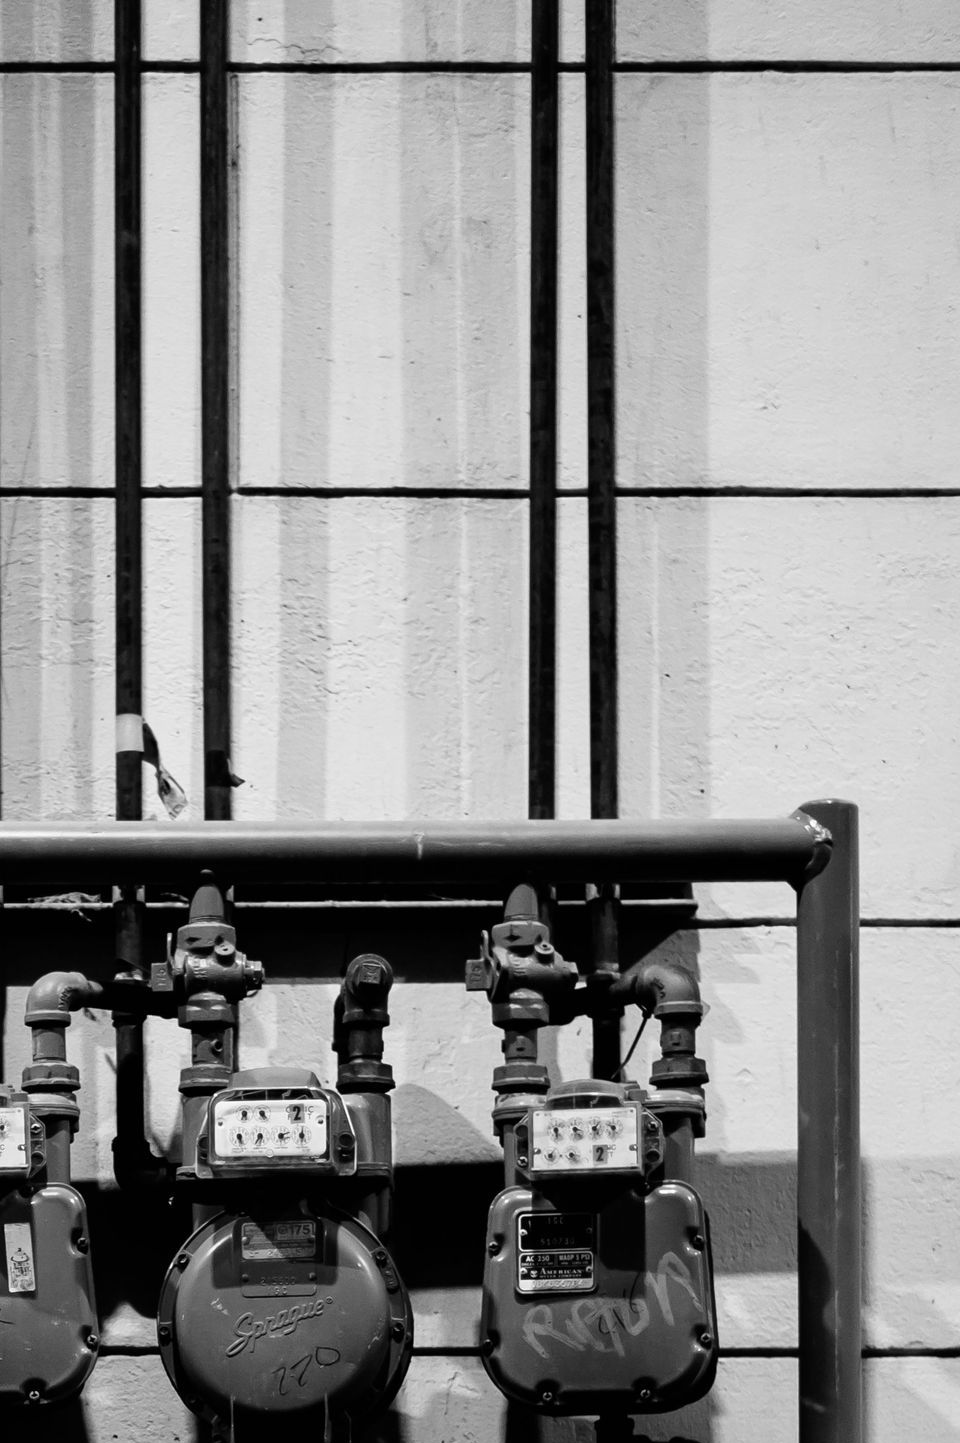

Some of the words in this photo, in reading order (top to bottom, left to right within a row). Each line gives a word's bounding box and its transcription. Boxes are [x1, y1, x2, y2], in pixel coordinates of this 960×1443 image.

[292, 1105, 302, 1121] 2
[595, 1146, 605, 1162] 2
[291, 1224, 311, 1235] 175
[539, 1267, 582, 1275] AMERICAN
[225, 1299, 325, 1358] Sprague
